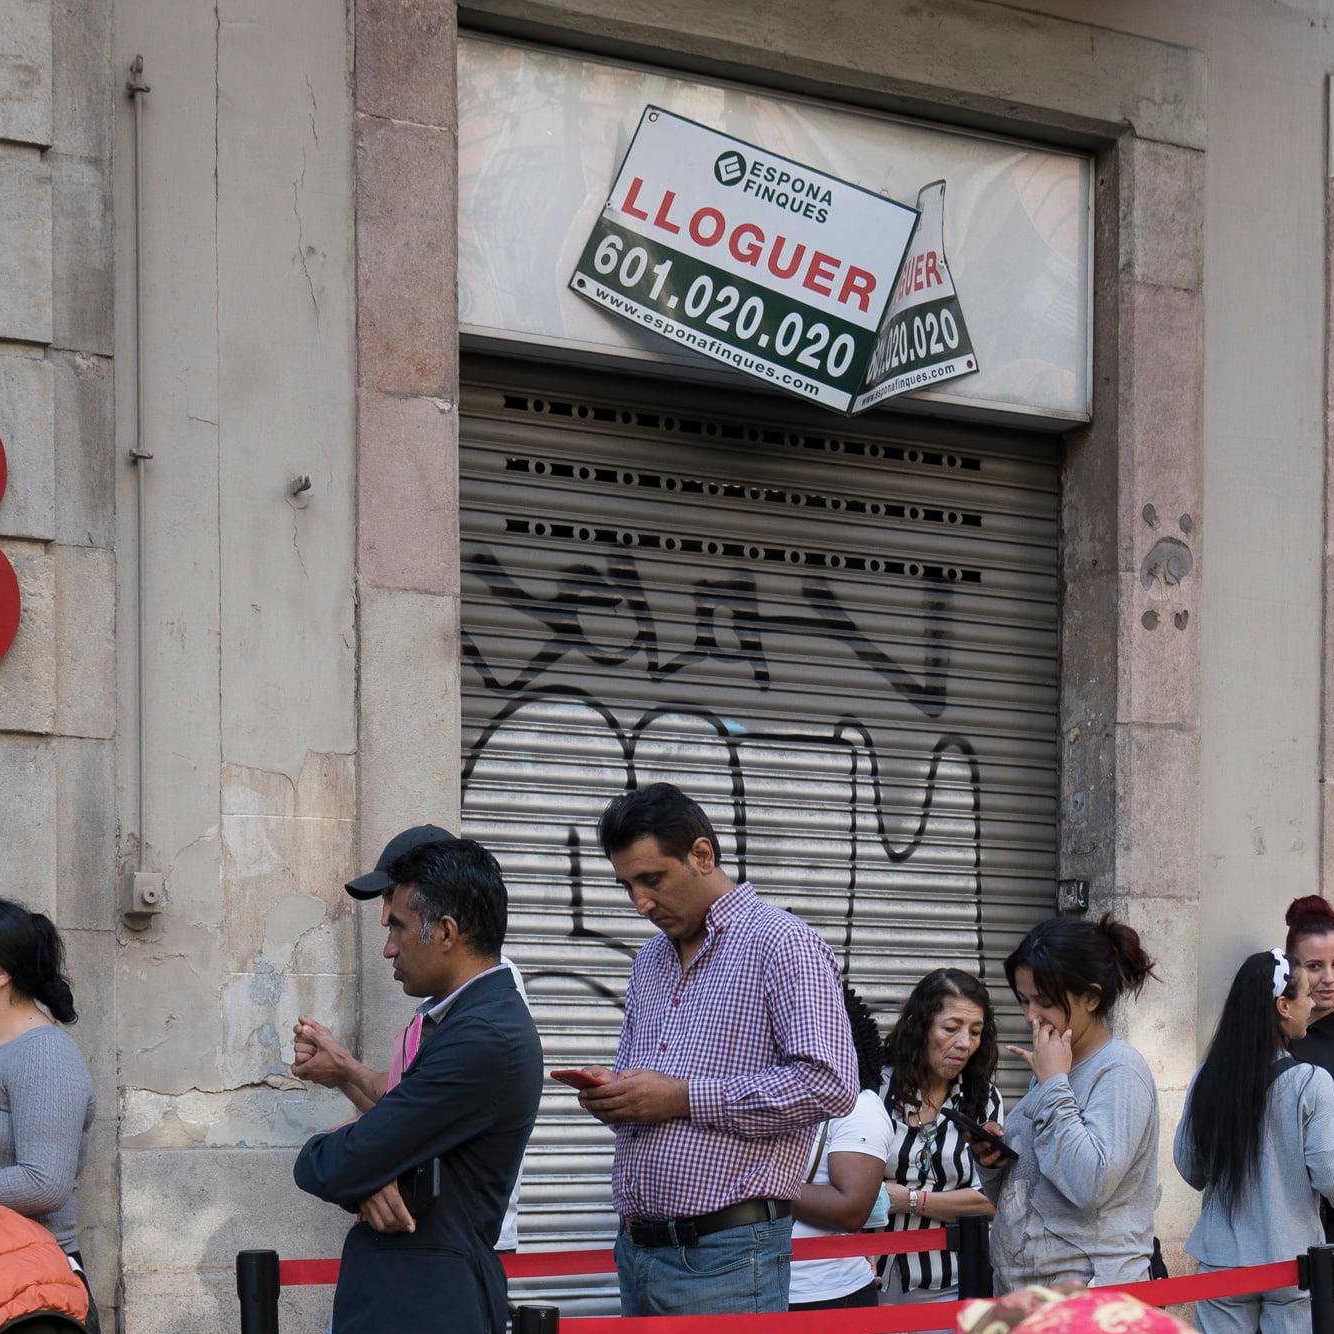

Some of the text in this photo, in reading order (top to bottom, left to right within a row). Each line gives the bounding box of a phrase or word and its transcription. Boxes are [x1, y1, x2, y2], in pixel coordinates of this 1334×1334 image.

[743, 178, 828, 225] FINQUES
[749, 160, 834, 207] ESPONA
[620, 177, 878, 313] LLOGUER
[593, 234, 855, 378] 601.020.020
[595, 285, 820, 397] www.esponafinques.com
